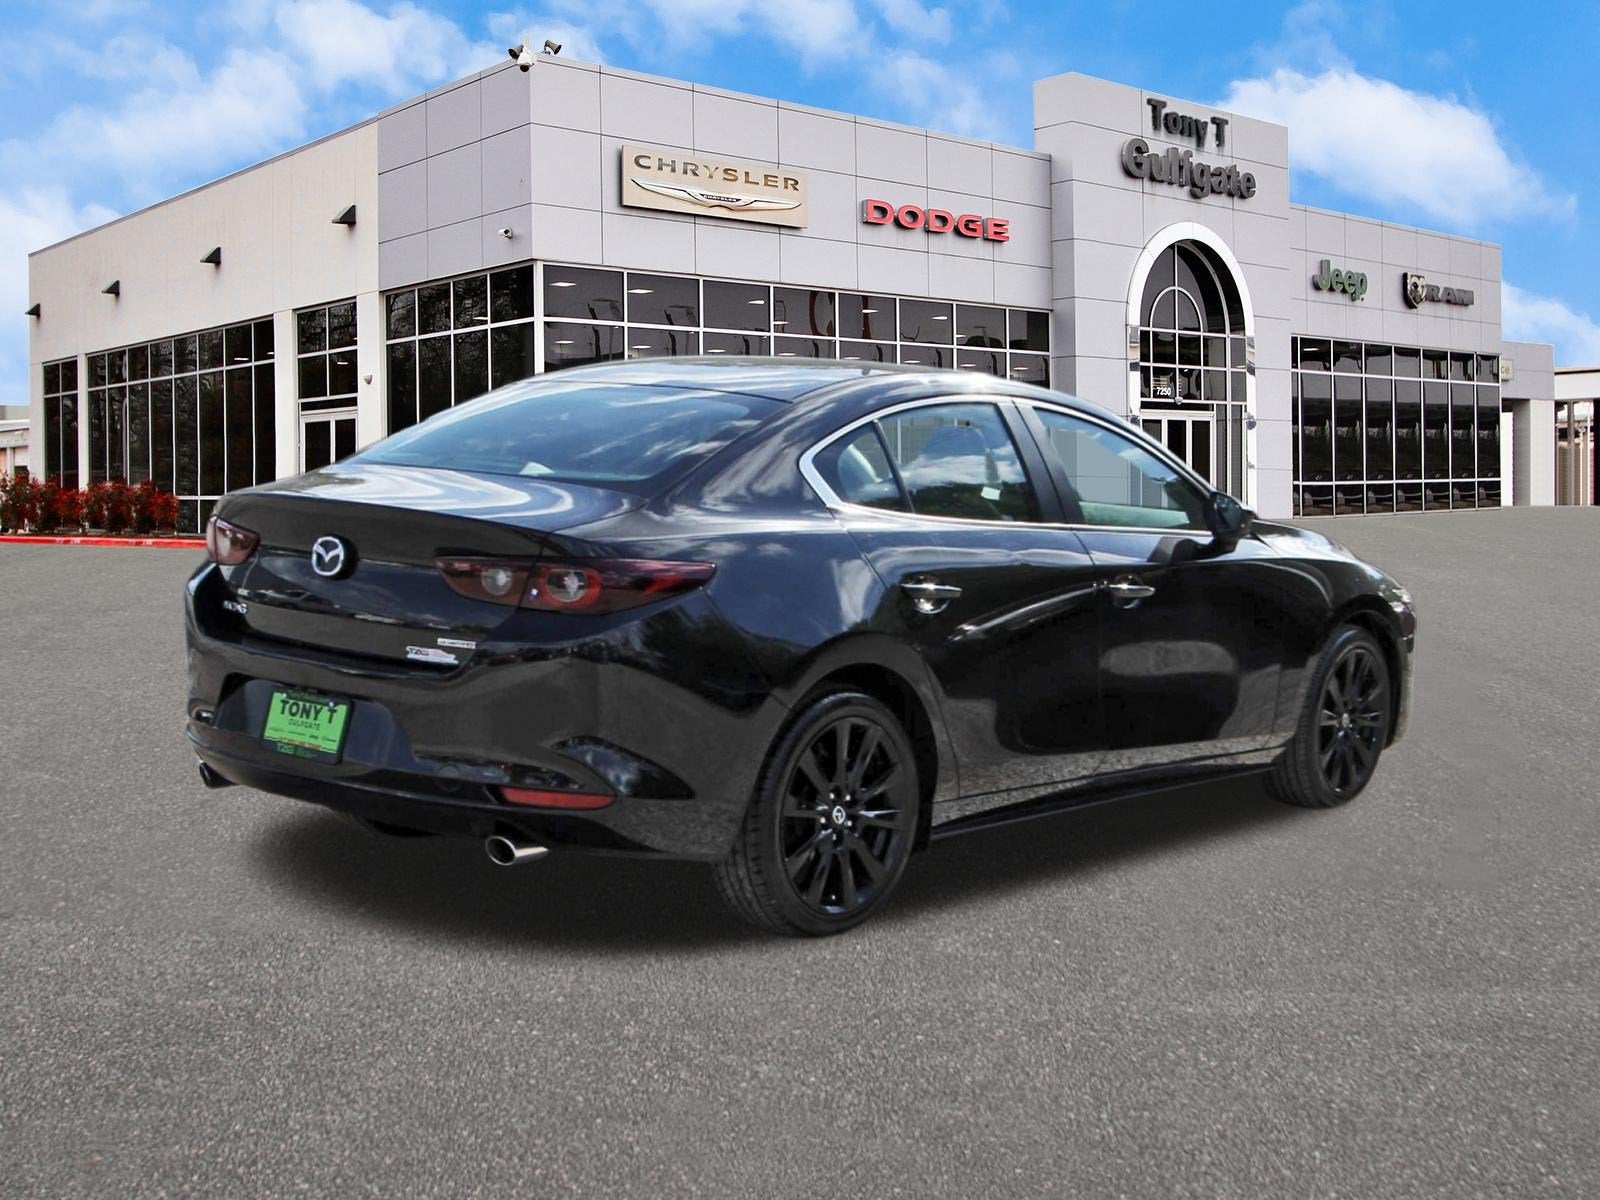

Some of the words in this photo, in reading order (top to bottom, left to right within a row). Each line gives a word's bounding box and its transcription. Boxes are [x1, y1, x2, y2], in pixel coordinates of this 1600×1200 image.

[1146, 98, 1208, 147] Tony
[1210, 116, 1229, 148] T
[634, 154, 800, 192] CHRYSLER
[1121, 137, 1257, 199] Gulfgate
[863, 198, 1010, 242] DODGE
[1313, 259, 1368, 302] Jeep
[1425, 284, 1475, 306] RAM
[1156, 386, 1171, 396] 7250
[280, 698, 324, 721] TONY
[327, 707, 338, 725] T
